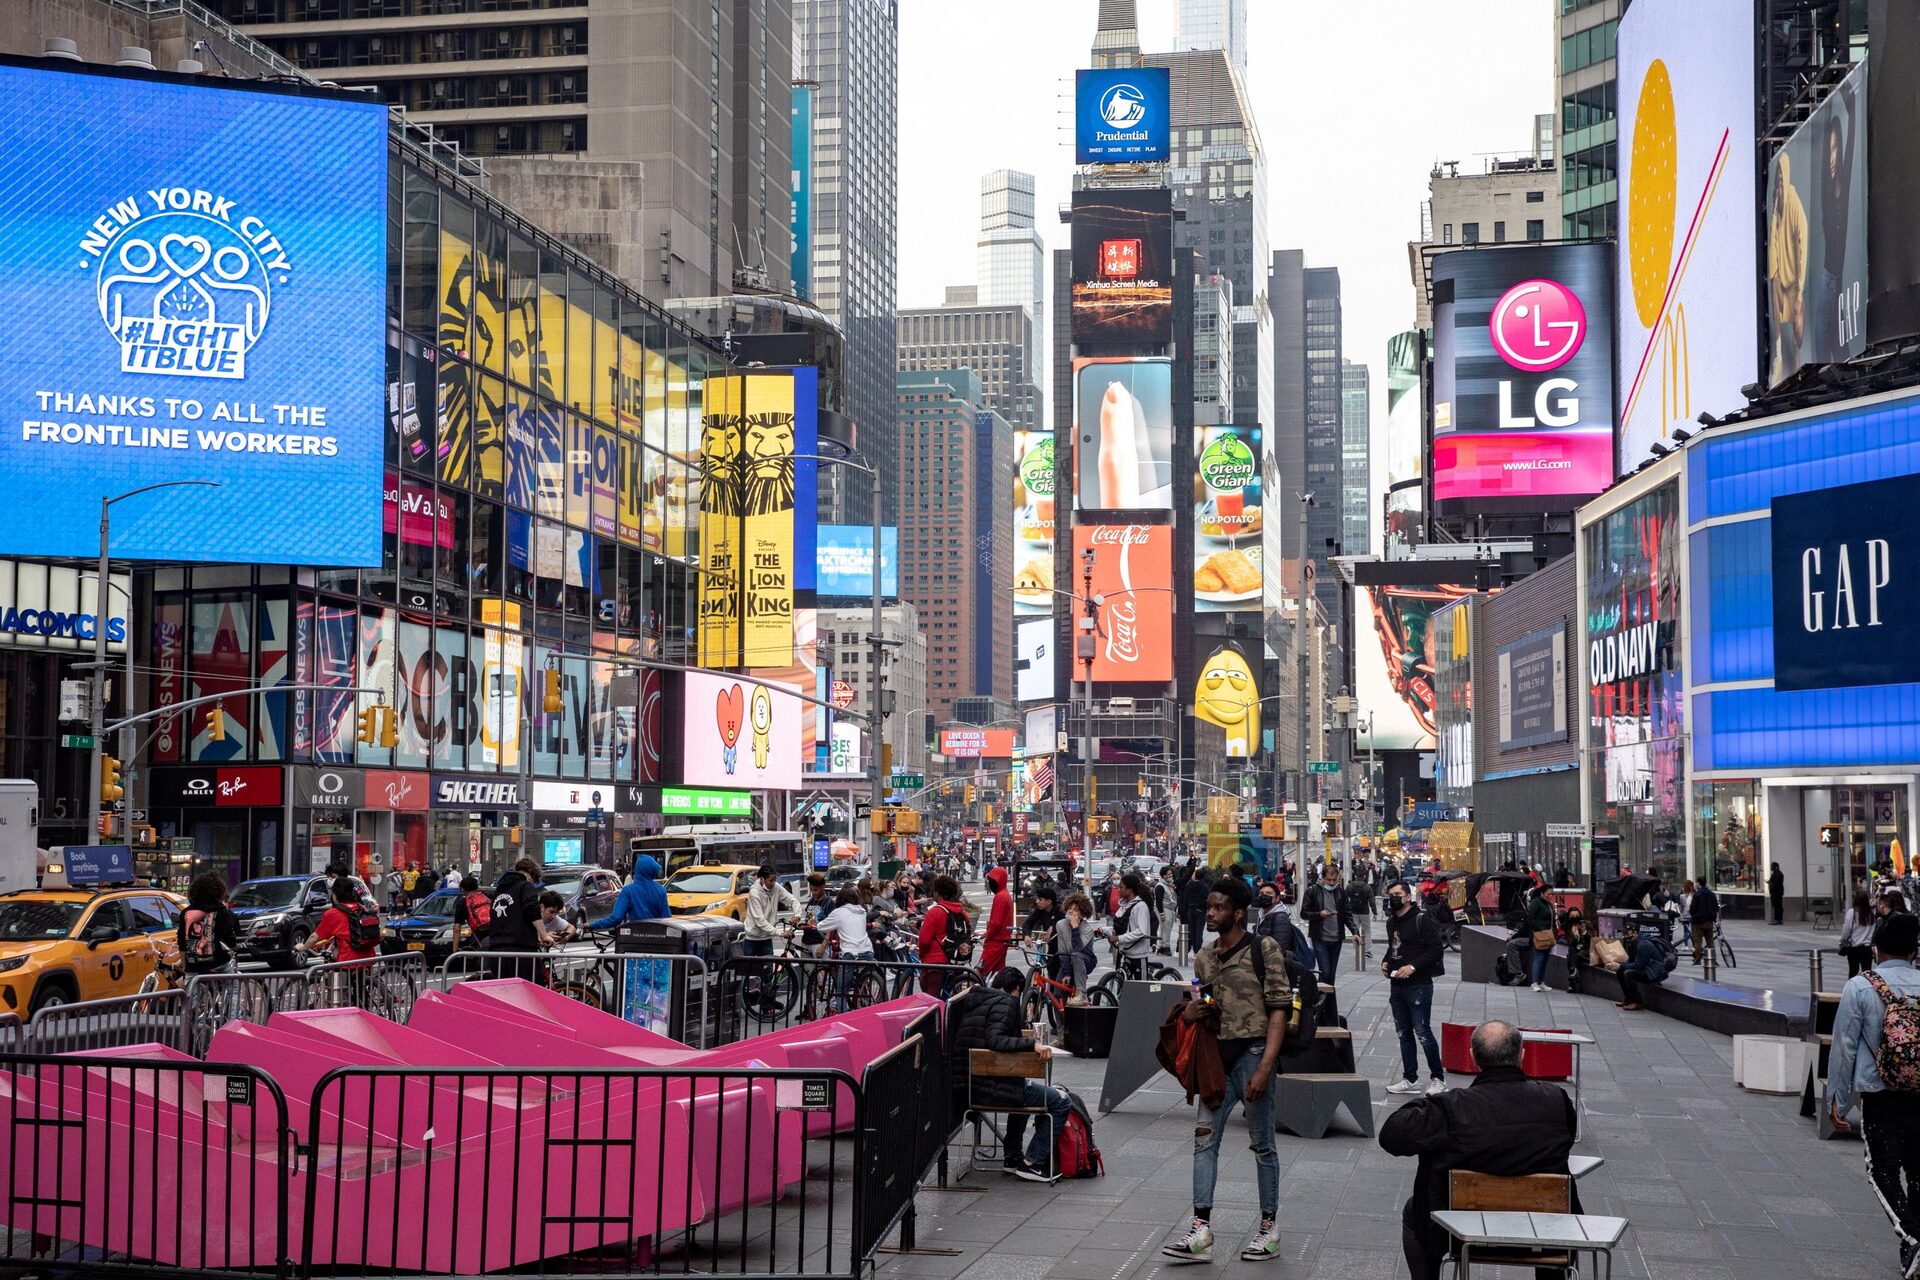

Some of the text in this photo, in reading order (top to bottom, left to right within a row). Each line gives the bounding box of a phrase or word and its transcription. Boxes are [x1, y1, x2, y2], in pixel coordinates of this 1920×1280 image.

[1095, 130, 1149, 141] Prudential
[79, 187, 292, 277] NEW YORK CITY
[1086, 280, 1159, 289] Xinhua Screen Media
[1837, 281, 1860, 347] GAP
[124, 321, 240, 350] #LIGHT
[127, 346, 238, 373] ITBLUE
[35, 390, 327, 427] THANKS TO ALL THE
[1498, 377, 1580, 429] LG
[22, 421, 339, 457] FRONTLINE WORKERS
[1206, 462, 1252, 476] Green
[1211, 474, 1254, 488] Giant
[1021, 519, 1036, 529] NO
[1200, 514, 1255, 525] NO POTATO
[620, 525, 628, 535] ON
[1091, 524, 1152, 545] Coca-Cola
[755, 539, 776, 549] Disney
[753, 554, 780, 566] THE
[749, 568, 786, 591] LION
[1801, 538, 1891, 633] GAP
[746, 592, 791, 618] KING
[160, 622, 175, 688] NEWS
[295, 617, 307, 684] NEWS
[1590, 635, 1616, 686] OLD
[1617, 620, 1660, 680] NAVY
[76, 737, 80, 746] 7
[948, 732, 962, 740] LOVE
[1310, 763, 1317, 772] W
[1318, 763, 1330, 772] 44
[893, 777, 901, 787] W
[903, 777, 914, 787] 44
[1618, 780, 1648, 800] OLD NAVY
[311, 794, 349, 805] OAKLEY
[437, 780, 526, 804] SKECHER
[1015, 813, 1025, 832] tkts
[70, 852, 87, 860] Book
[72, 862, 100, 873] anything.
